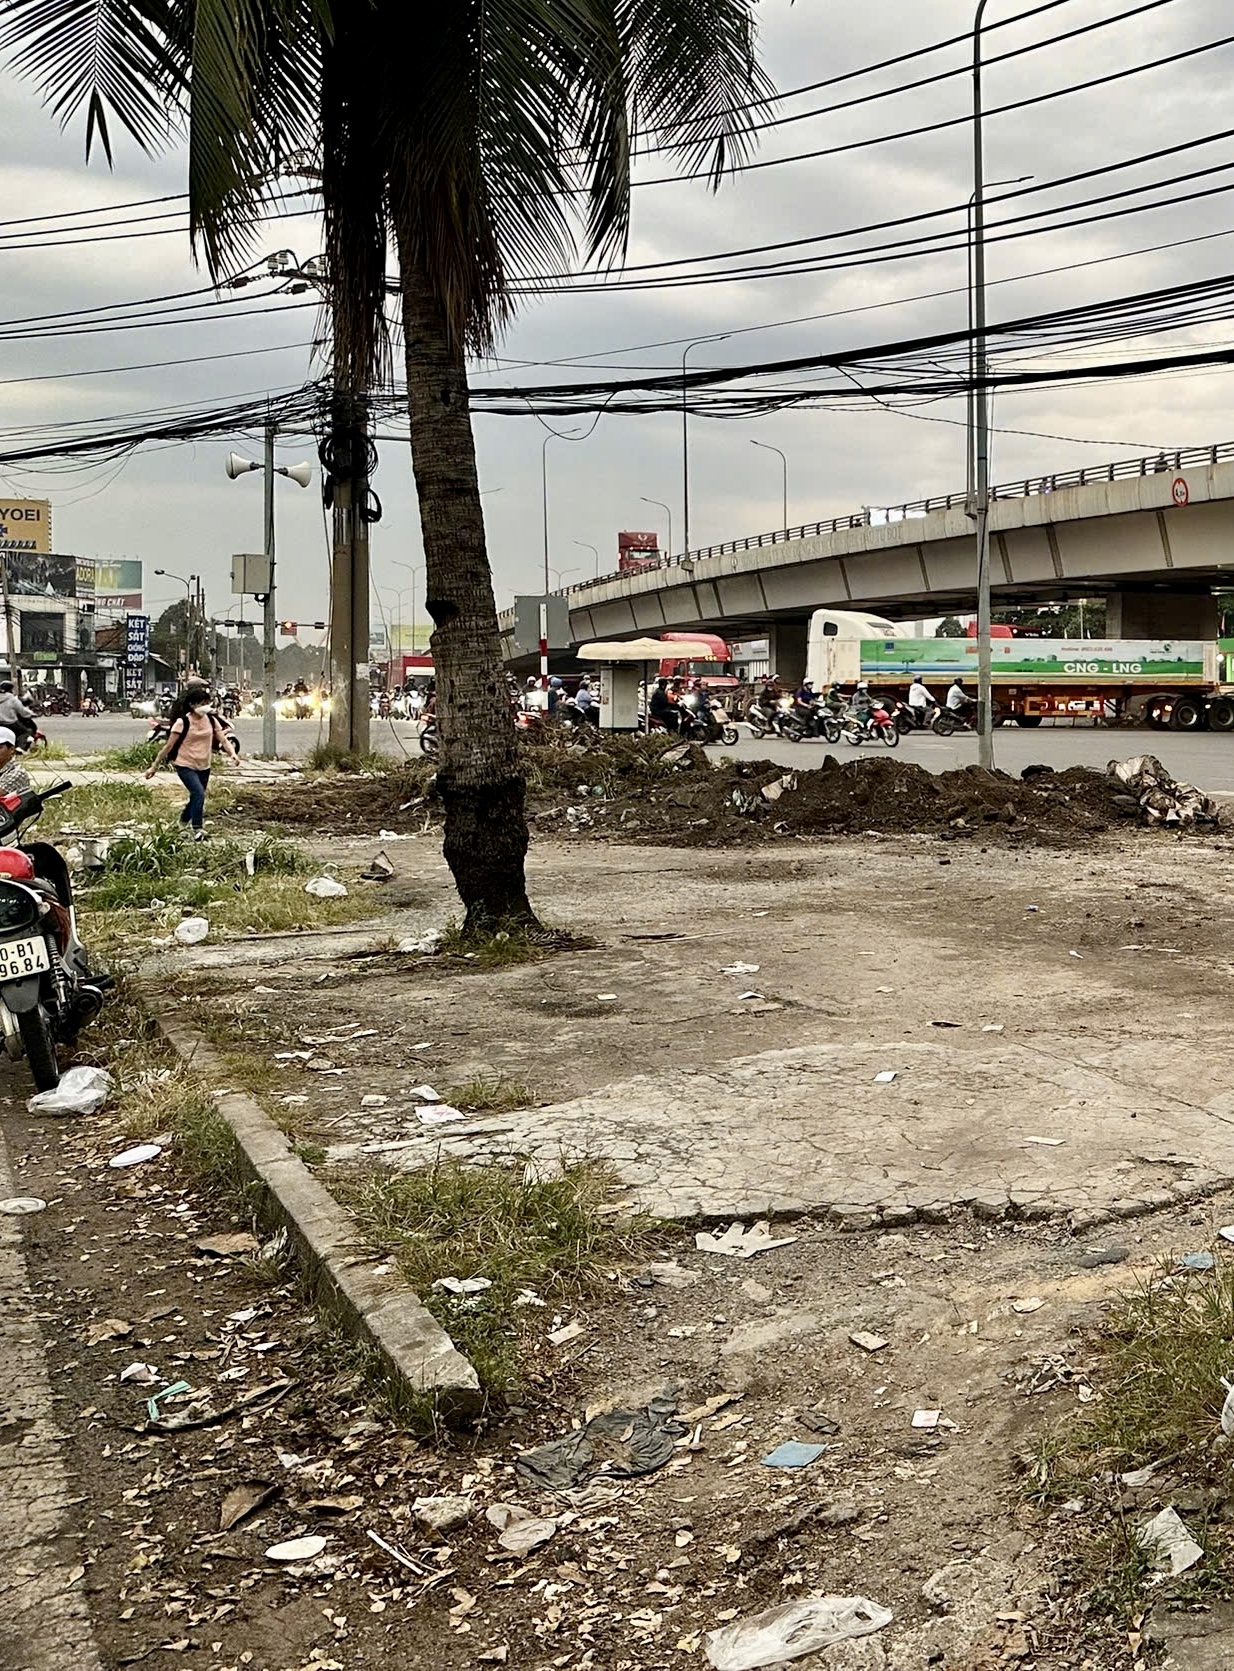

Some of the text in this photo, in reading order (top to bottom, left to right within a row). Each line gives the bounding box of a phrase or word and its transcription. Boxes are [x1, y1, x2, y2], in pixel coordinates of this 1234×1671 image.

[1063, 662, 1099, 674] CNG
[1112, 662, 1142, 674] LNG
[0, 955, 44, 977] 96.84
